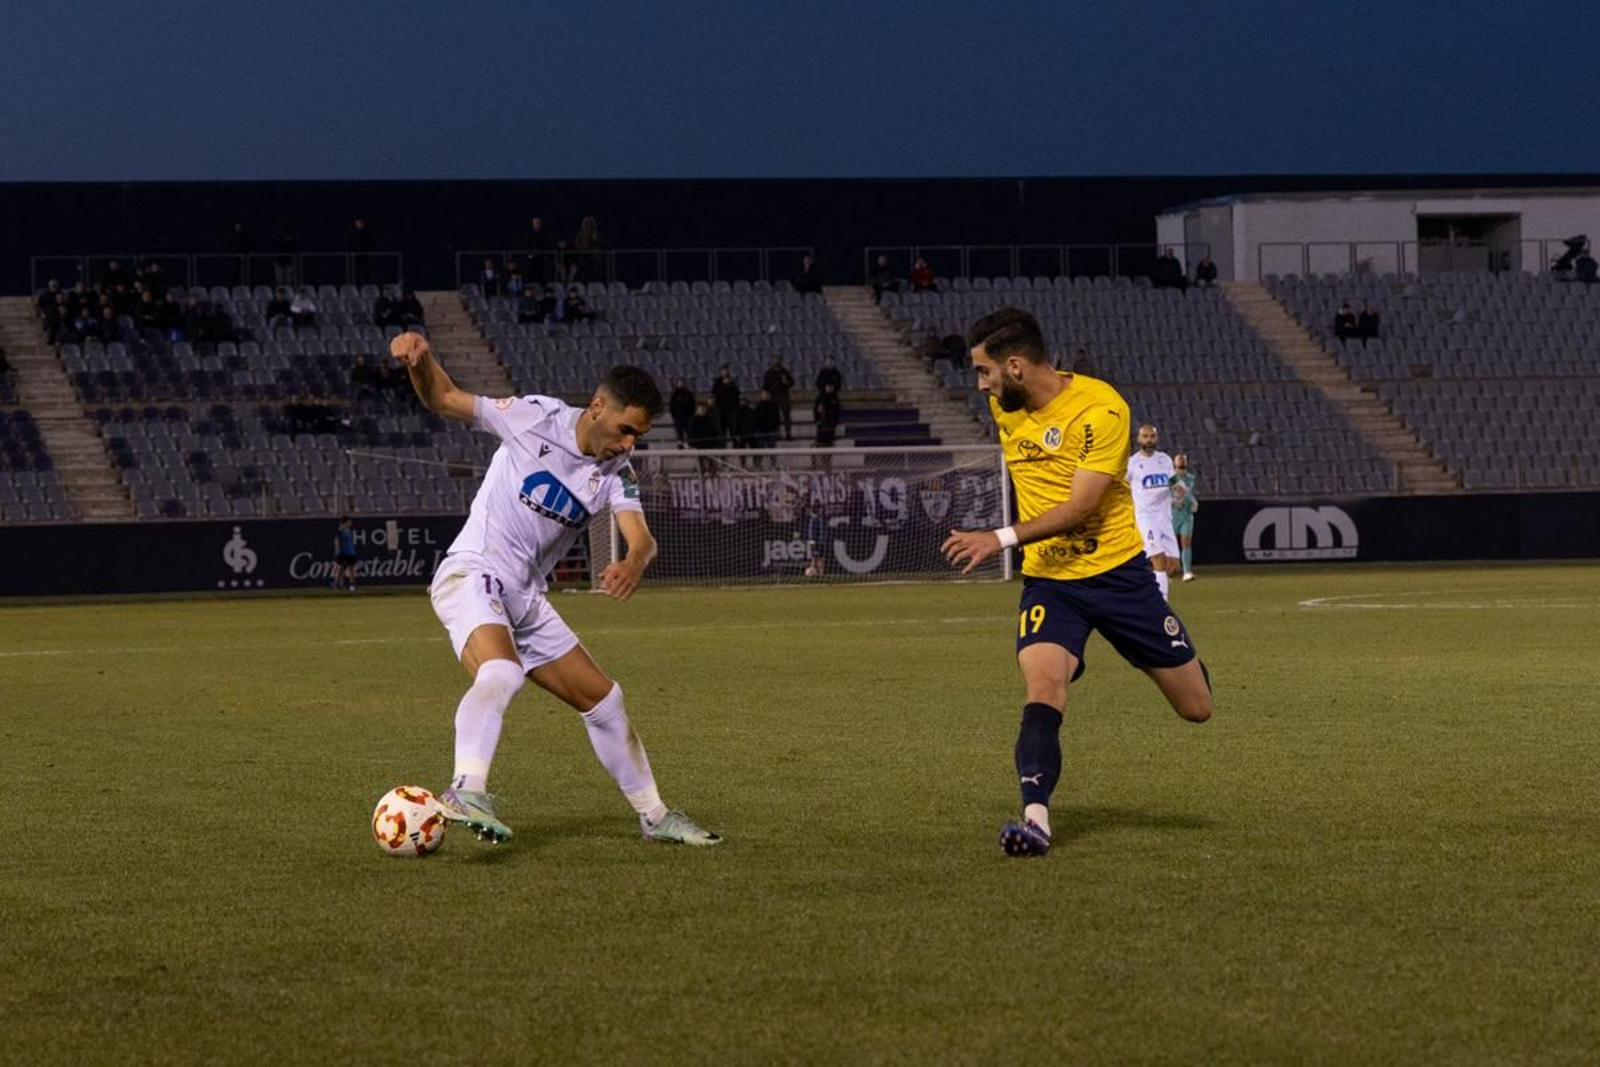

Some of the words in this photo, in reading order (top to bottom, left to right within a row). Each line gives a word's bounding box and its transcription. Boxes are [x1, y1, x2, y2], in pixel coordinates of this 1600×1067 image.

[705, 475, 769, 509] NORTH
[353, 528, 437, 545] HOEL
[289, 550, 425, 580] Conestable
[1019, 604, 1046, 639] 19
